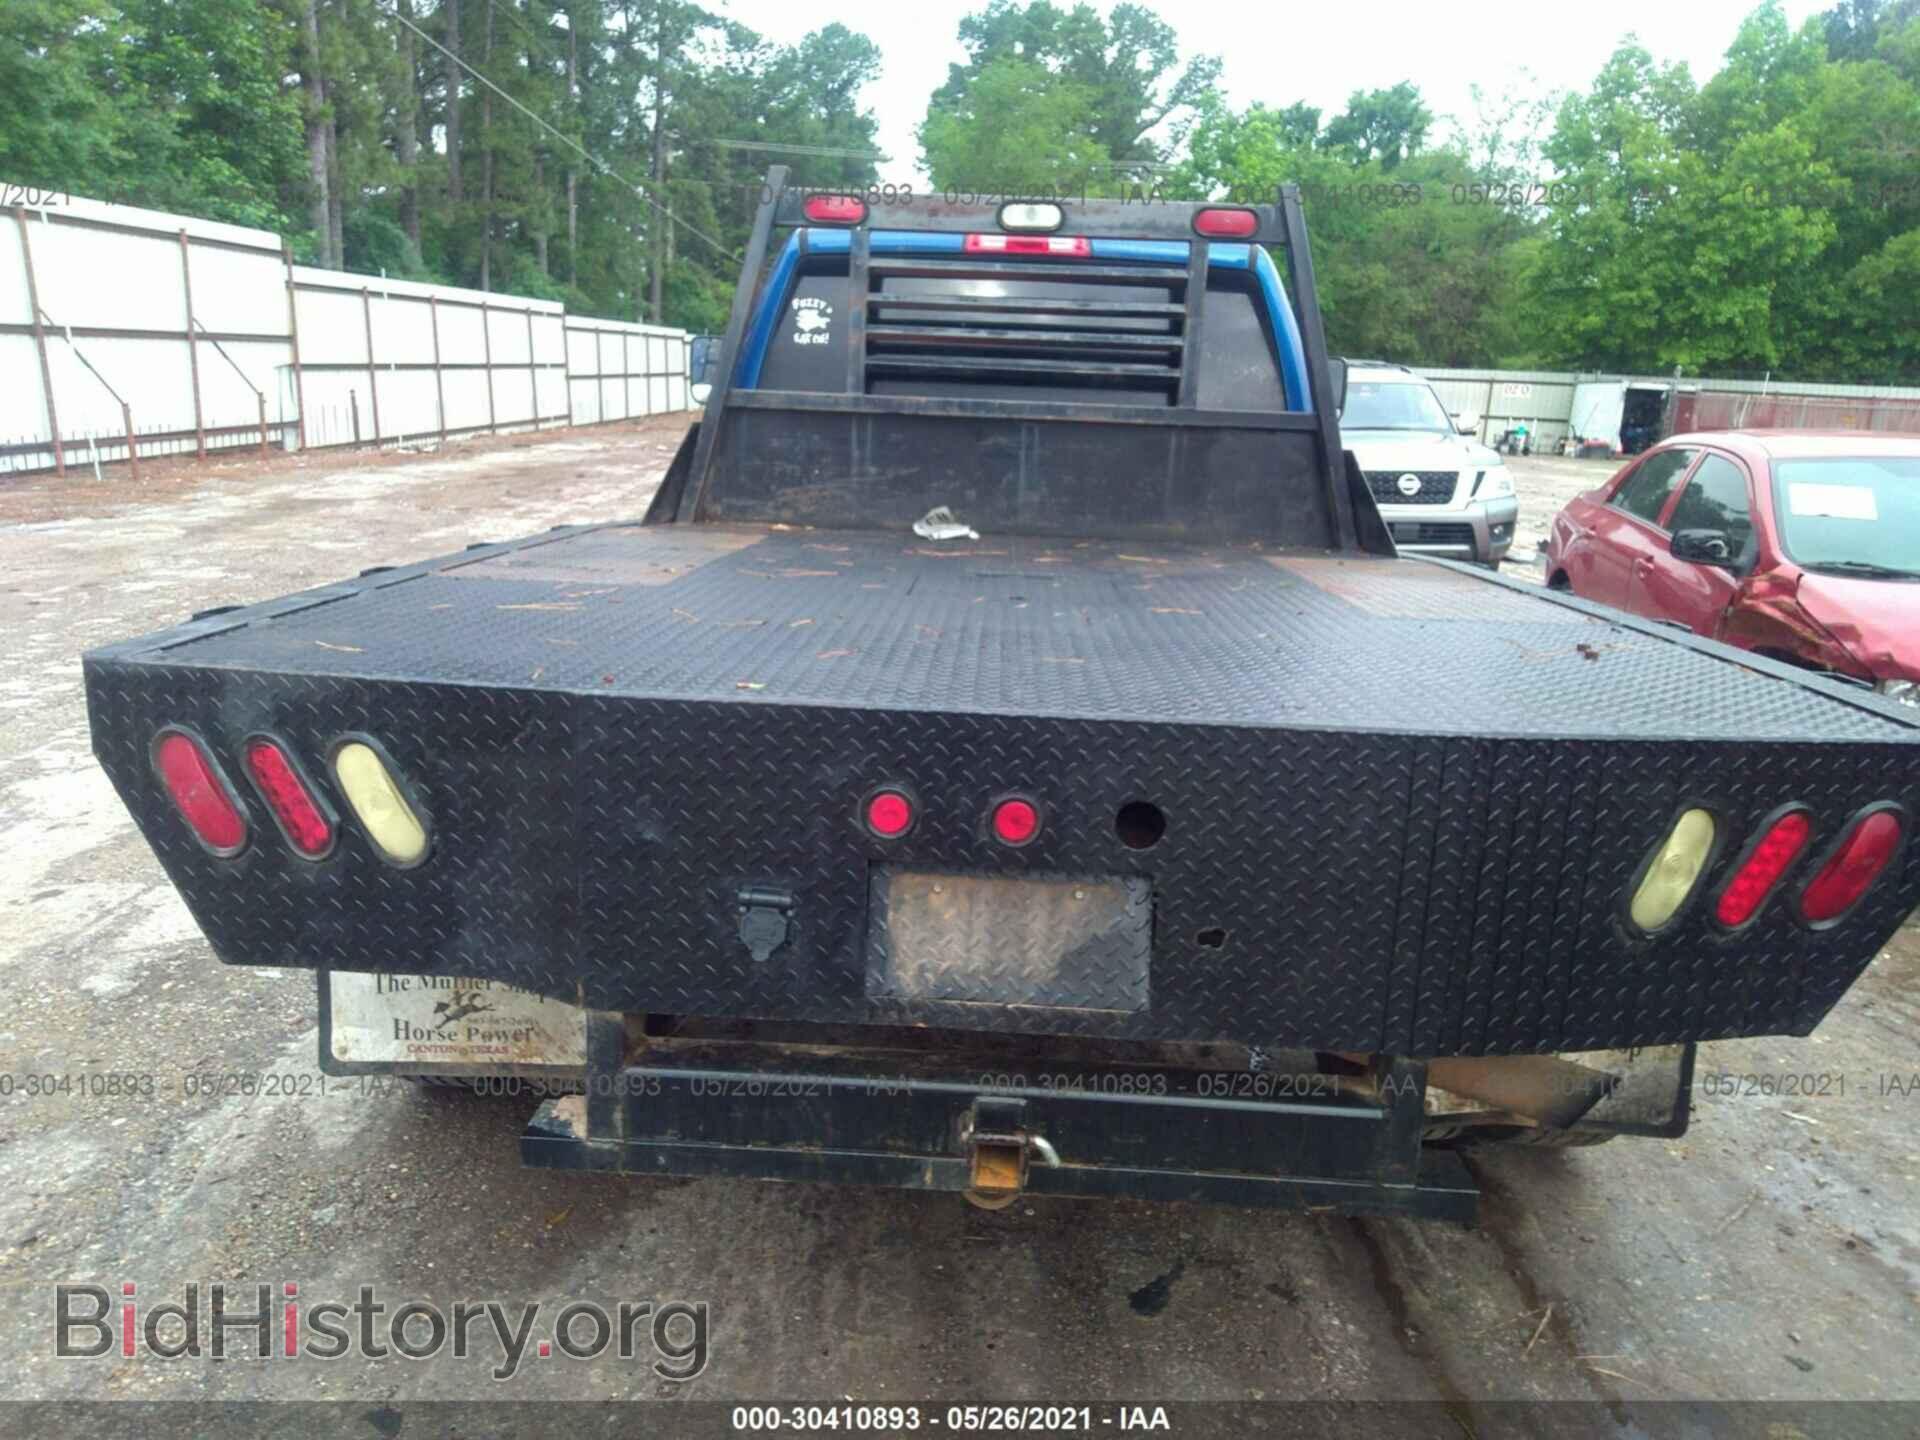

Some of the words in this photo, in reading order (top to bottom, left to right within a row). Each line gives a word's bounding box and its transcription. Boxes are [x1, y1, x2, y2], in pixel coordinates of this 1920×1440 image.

[393, 1018, 458, 1042] Horse
[467, 1027, 535, 1043] Power
[408, 1044, 457, 1054] CANTON
[470, 1045, 511, 1055] TEXAS
